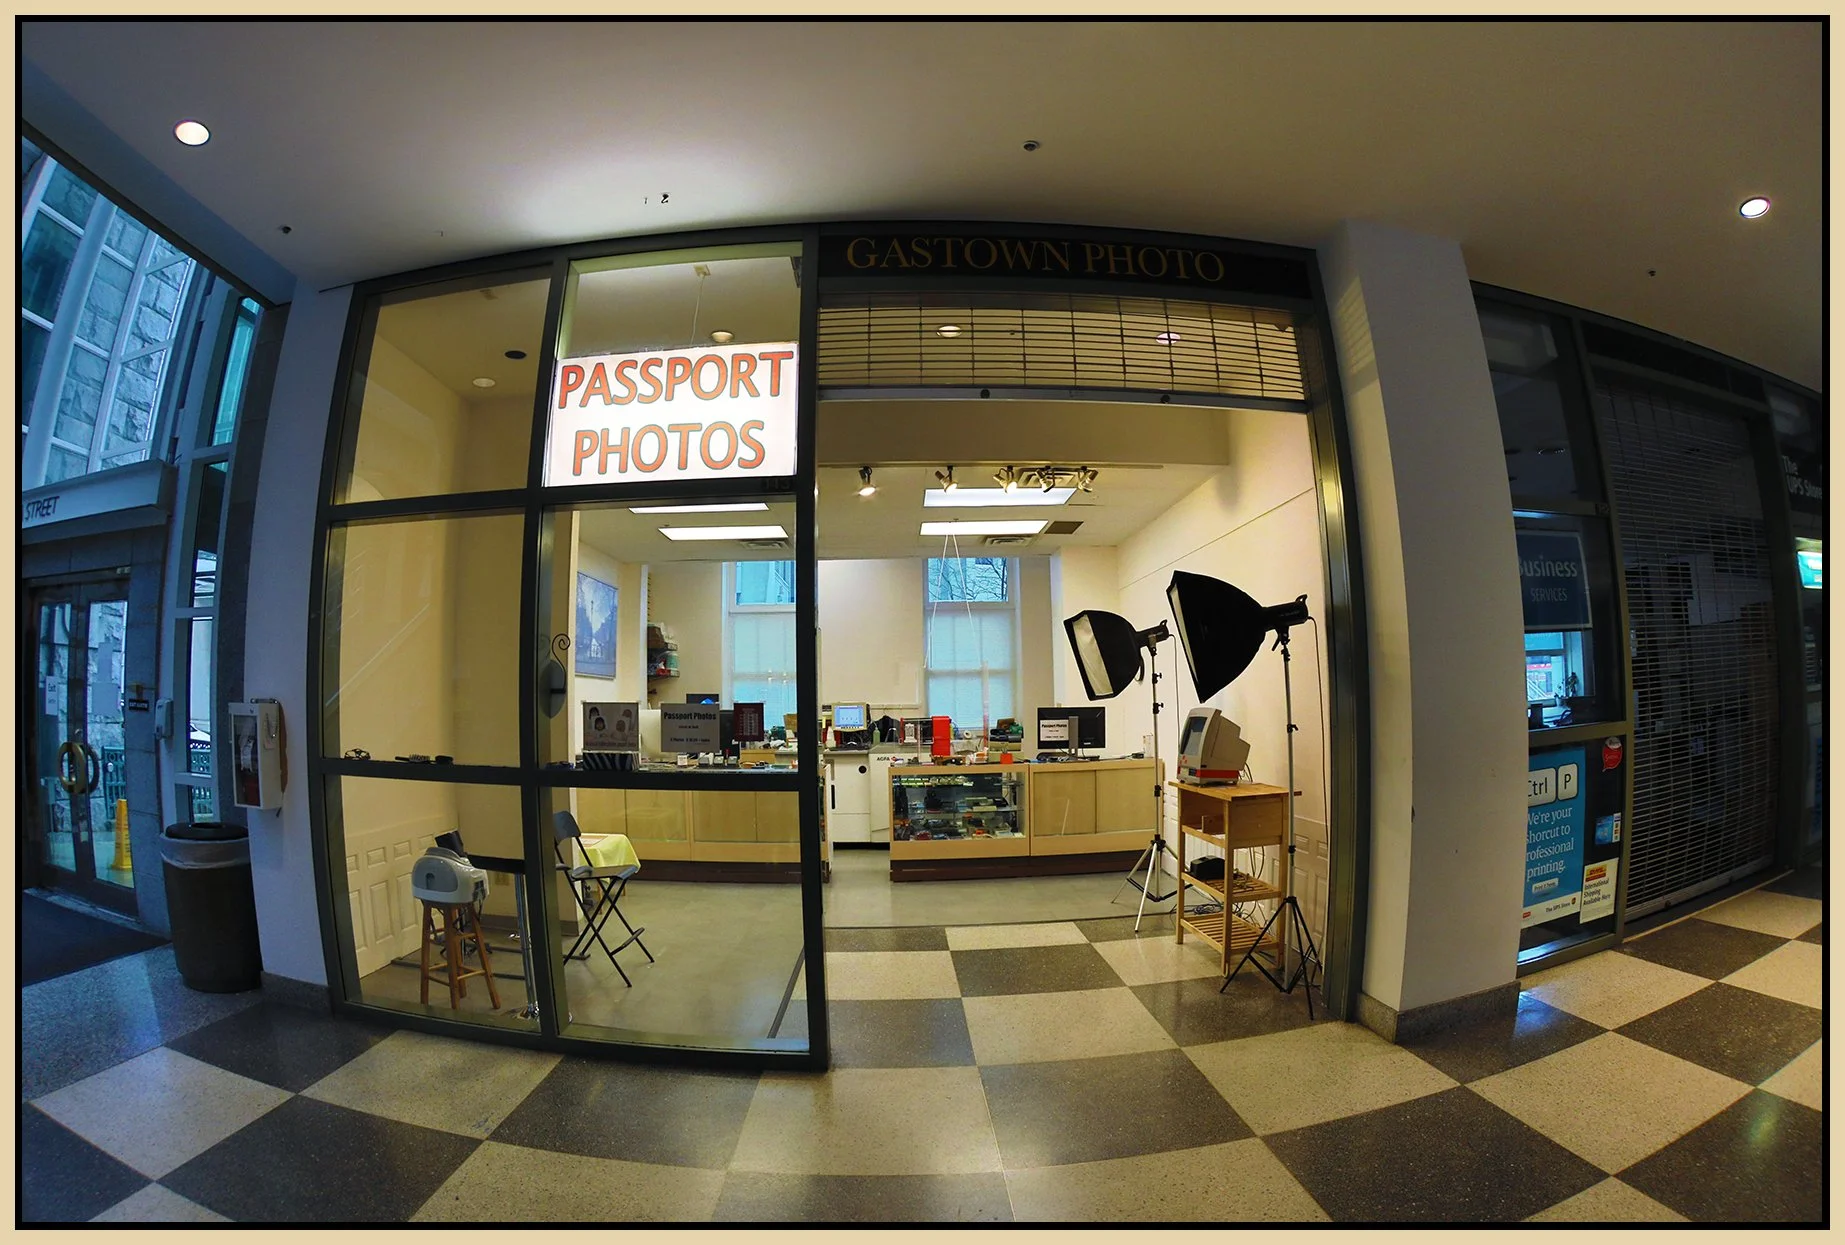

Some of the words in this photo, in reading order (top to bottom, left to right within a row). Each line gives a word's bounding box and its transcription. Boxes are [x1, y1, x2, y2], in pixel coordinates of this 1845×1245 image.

[846, 237, 1071, 273] GASTOWN
[1081, 242, 1225, 282] PHOTO
[558, 351, 794, 409] PASSPORT
[572, 419, 766, 476] PHOTOS
[1781, 455, 1799, 475] The
[1786, 474, 1804, 496] UPS
[25, 496, 60, 521] STREET
[1530, 587, 1569, 603] SERVICES
[663, 711, 693, 721] Passport
[693, 711, 717, 721] Photos
[1564, 773, 1572, 790] P
[1551, 806, 1573, 825] your
[1560, 824, 1571, 837] to
[1526, 837, 1574, 862] rofessional
[1584, 878, 1609, 890] International
[1583, 889, 1601, 899] Shipping
